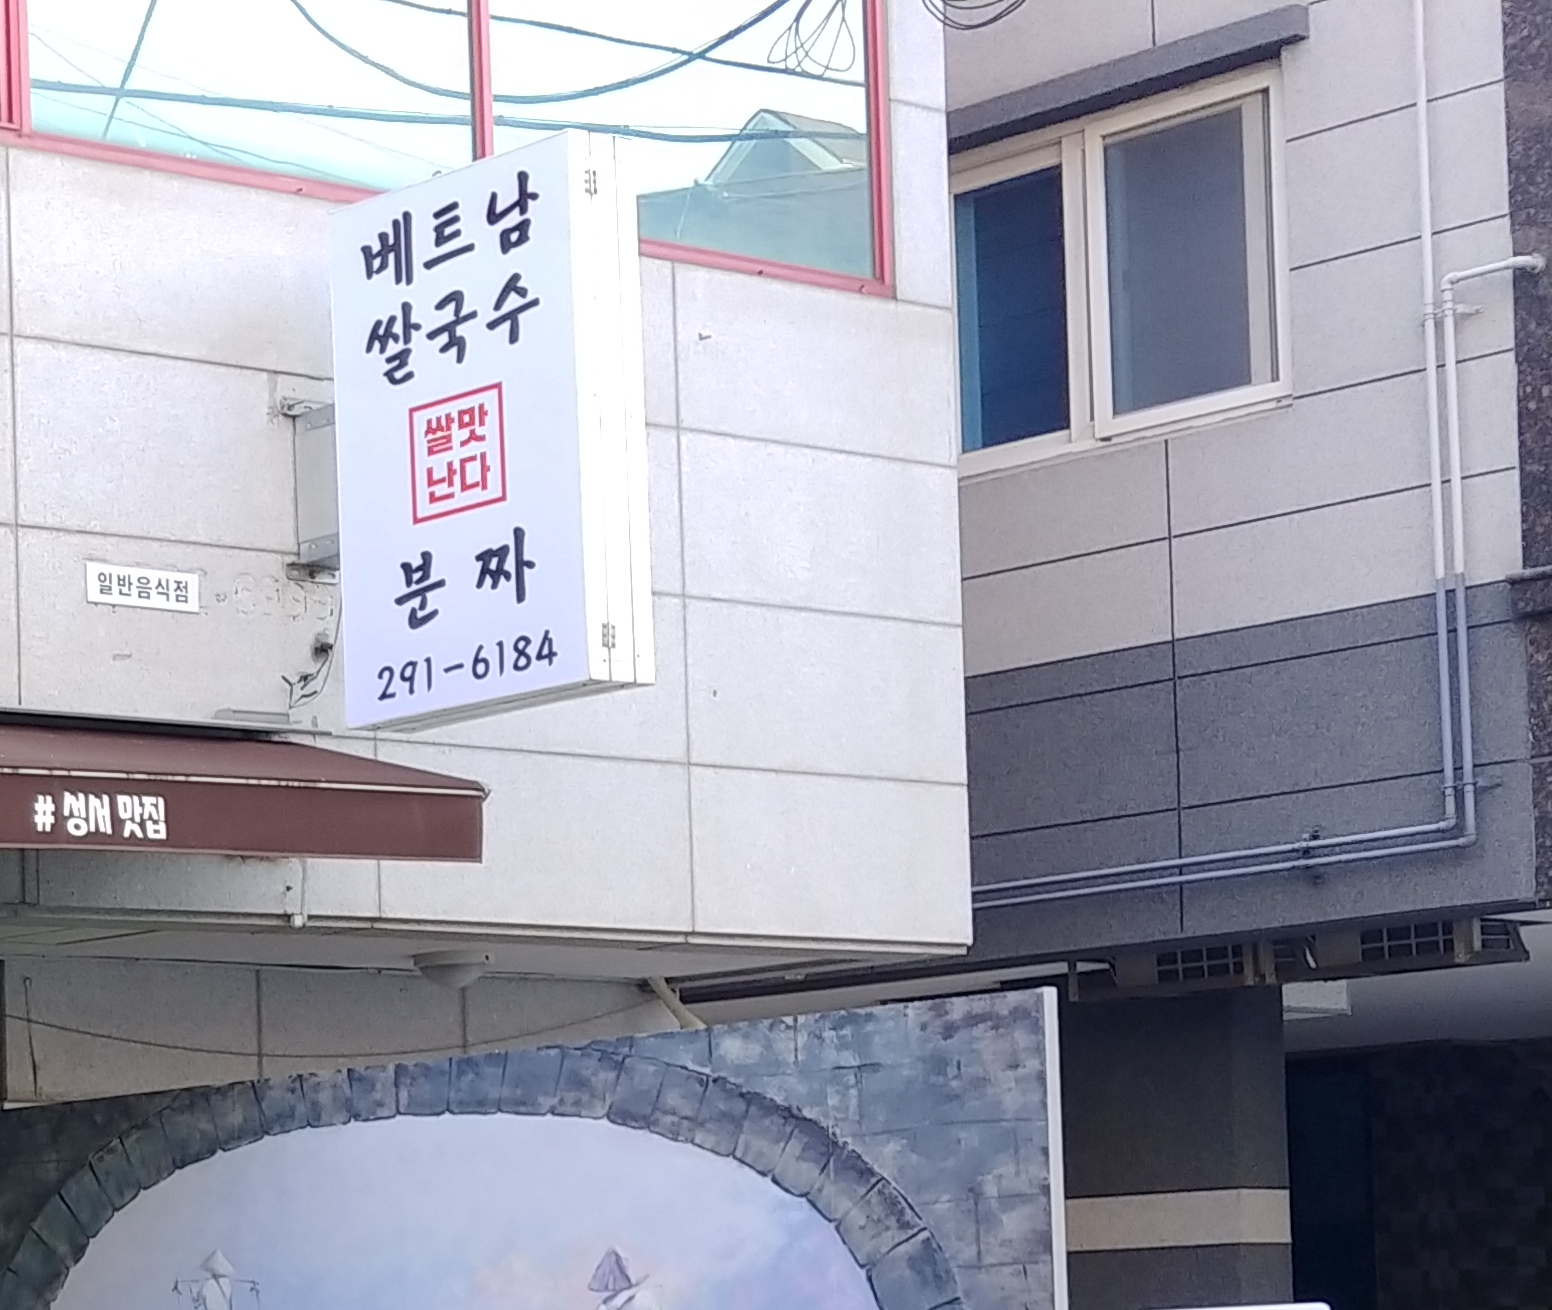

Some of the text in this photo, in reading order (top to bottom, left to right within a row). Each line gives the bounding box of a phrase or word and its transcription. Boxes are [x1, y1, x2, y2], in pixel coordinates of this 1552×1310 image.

[359, 171, 540, 287] 베트남
[364, 272, 540, 385] 쌀국수
[424, 403, 489, 457] 쌀맛
[427, 452, 491, 505] 난다
[97, 570, 190, 604] 일반음식점
[377, 629, 558, 701] 291-6184
[63, 791, 112, 837] 성서
[116, 794, 167, 840] 맛집
